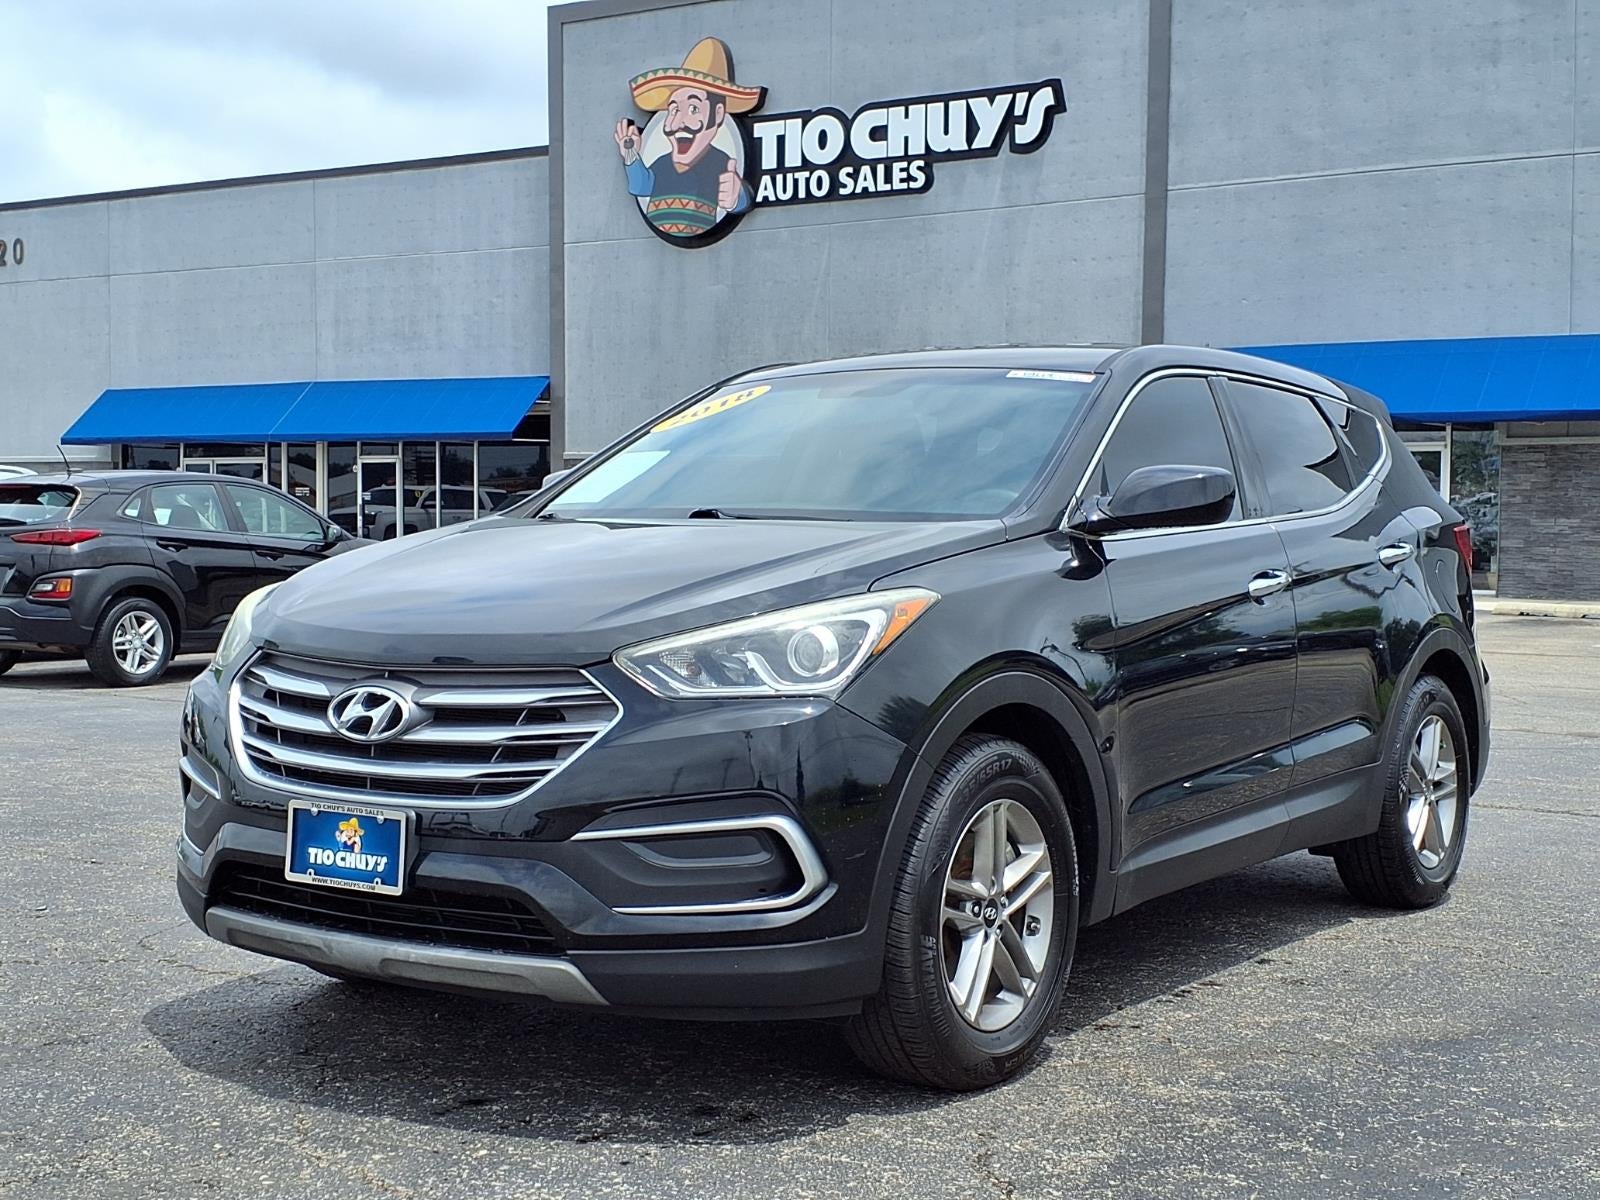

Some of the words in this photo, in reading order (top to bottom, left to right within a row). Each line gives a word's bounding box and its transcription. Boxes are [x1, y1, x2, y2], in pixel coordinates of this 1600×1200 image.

[753, 114, 845, 170] TIO
[849, 86, 1056, 160] CHUY'S
[755, 169, 830, 203] AUTO
[838, 159, 926, 196] SALES
[322, 803, 346, 812] CHUY'S
[346, 806, 364, 814] AUTO
[364, 808, 385, 817] SALES
[307, 847, 335, 866] TIO
[335, 849, 388, 873] CHUY'S
[311, 876, 376, 891] WWW.TIOCHUYS.COM
